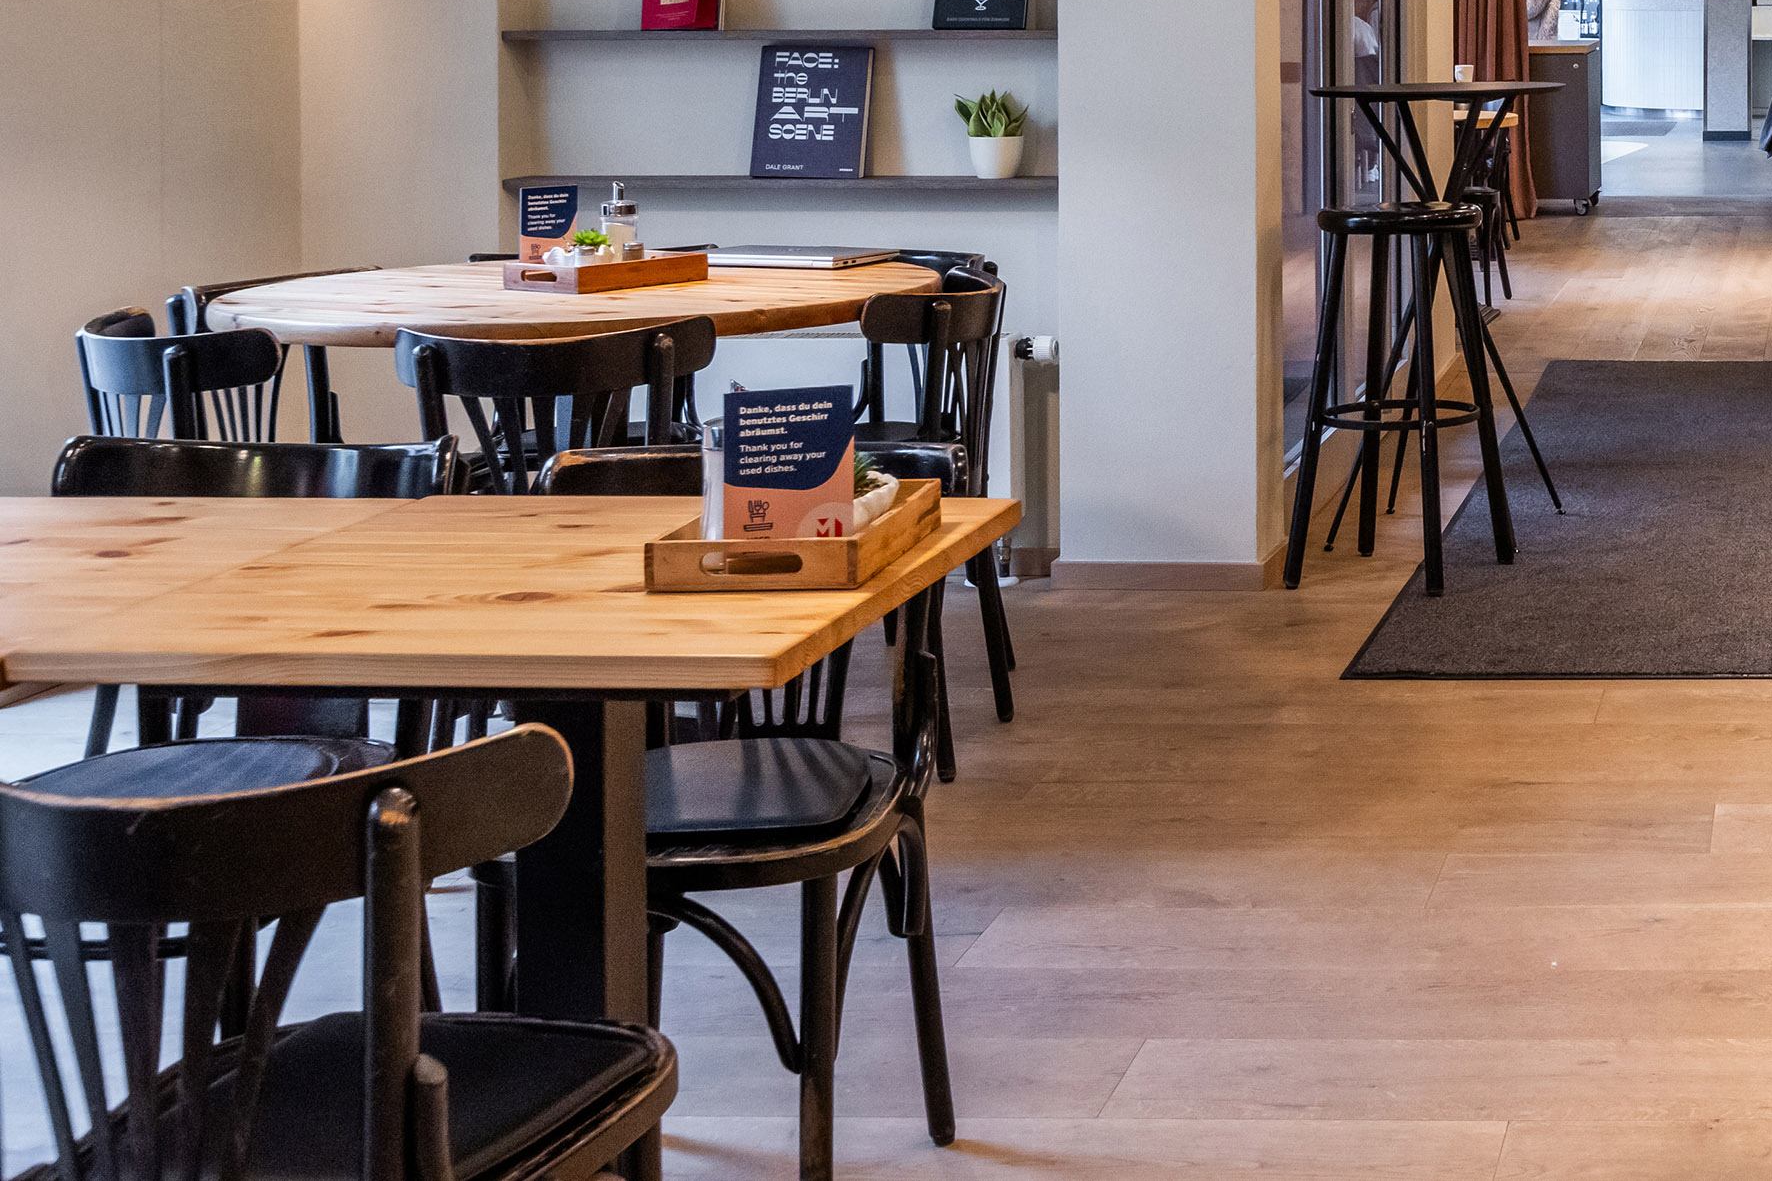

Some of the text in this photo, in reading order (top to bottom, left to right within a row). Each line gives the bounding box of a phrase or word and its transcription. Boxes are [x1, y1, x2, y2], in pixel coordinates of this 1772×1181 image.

[775, 52, 840, 68] FACE:
[772, 87, 838, 104] BERLIN
[770, 106, 859, 122] ART
[768, 123, 835, 140] SCENE
[739, 401, 833, 414] Danke, dass du dein
[739, 412, 829, 425] benutztes Geschirr
[739, 427, 788, 437] abräumst.
[739, 441, 804, 452] Thank you for
[739, 451, 827, 464] clearing away your
[739, 464, 798, 475] used dishes.
